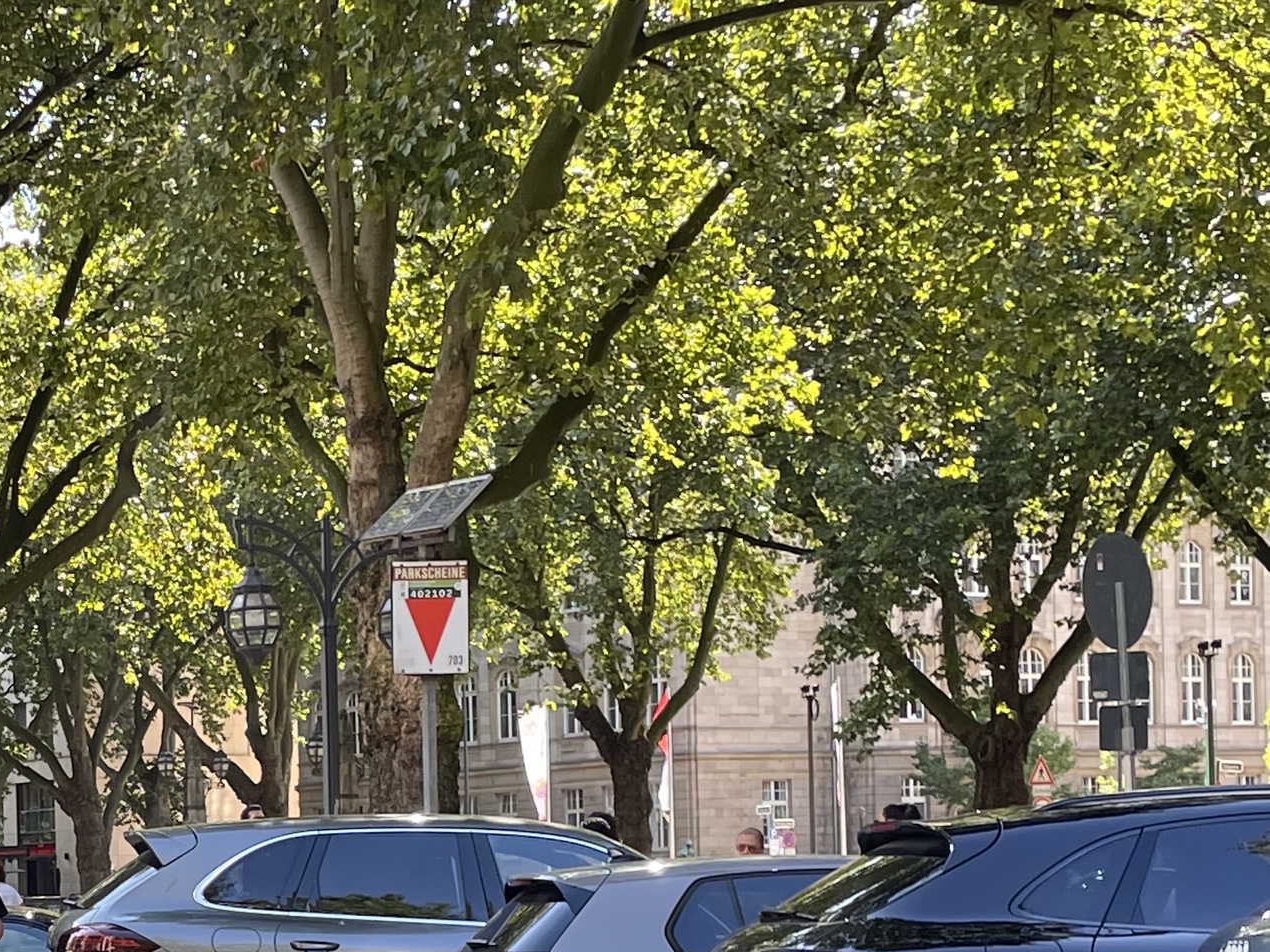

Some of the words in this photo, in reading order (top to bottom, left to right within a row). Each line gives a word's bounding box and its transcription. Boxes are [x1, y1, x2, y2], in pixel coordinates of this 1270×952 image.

[394, 566, 466, 580] PARKSCHEINE
[410, 589, 453, 598] 402102
[448, 654, 464, 666] 703
